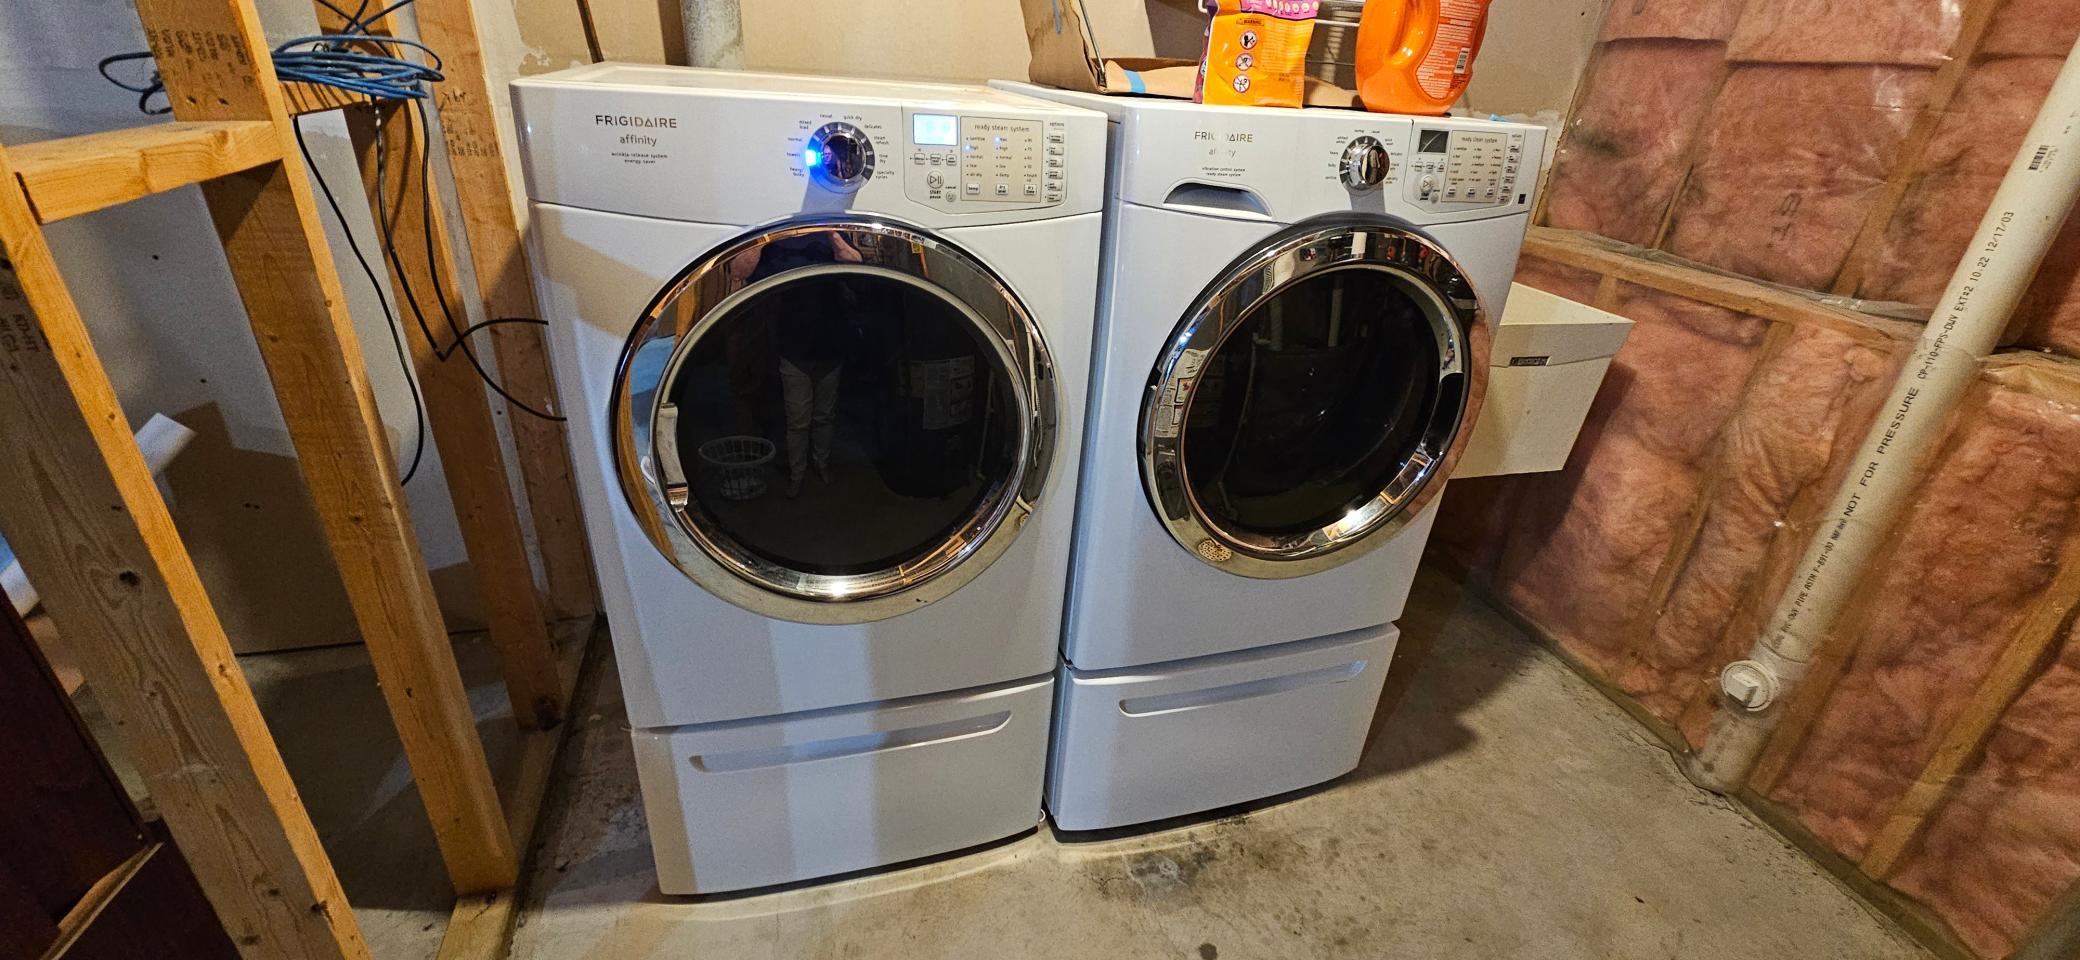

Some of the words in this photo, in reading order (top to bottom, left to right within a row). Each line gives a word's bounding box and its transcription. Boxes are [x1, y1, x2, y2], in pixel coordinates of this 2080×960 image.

[596, 115, 677, 128] FRIGIDAIRE
[974, 124, 990, 132] ready
[1010, 125, 1030, 133] system
[620, 134, 657, 147] affinity
[1796, 592, 1808, 606] PIPE
[1804, 573, 1817, 590] ASTM
[1844, 492, 1861, 517] NOT
[1860, 461, 1879, 487] FOR
[1876, 386, 1920, 454] PRESSURE
[1917, 313, 1958, 380] CP-110-FPS-DWV
[1985, 211, 2014, 252] 12/17/03
